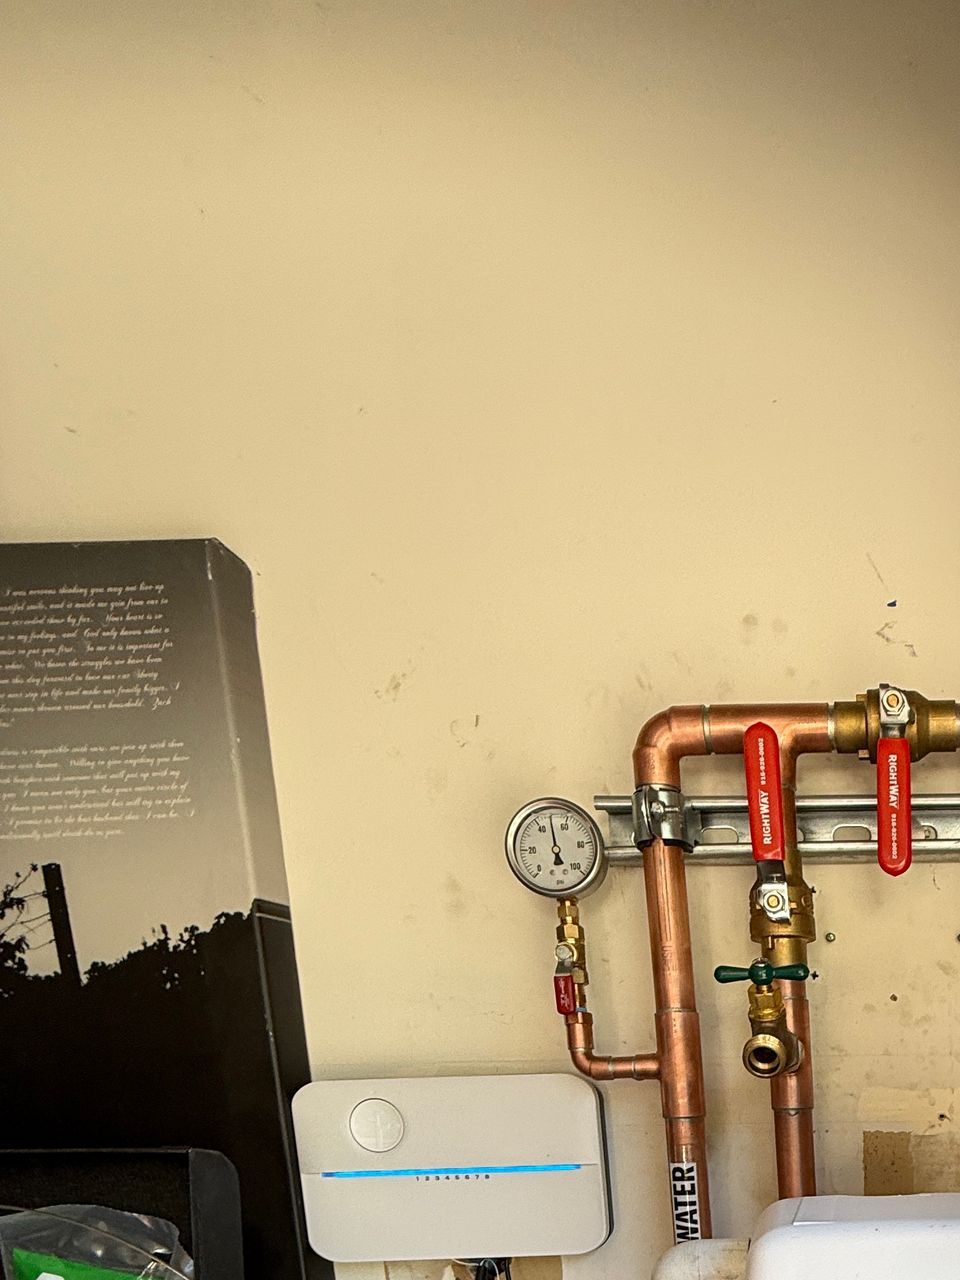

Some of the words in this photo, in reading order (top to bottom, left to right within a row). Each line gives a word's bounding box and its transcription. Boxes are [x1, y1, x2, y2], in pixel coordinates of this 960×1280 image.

[888, 754, 900, 808] RIGHTWAY
[759, 790, 773, 845] RIGHTWAY
[671, 1165, 700, 1244] WATER
